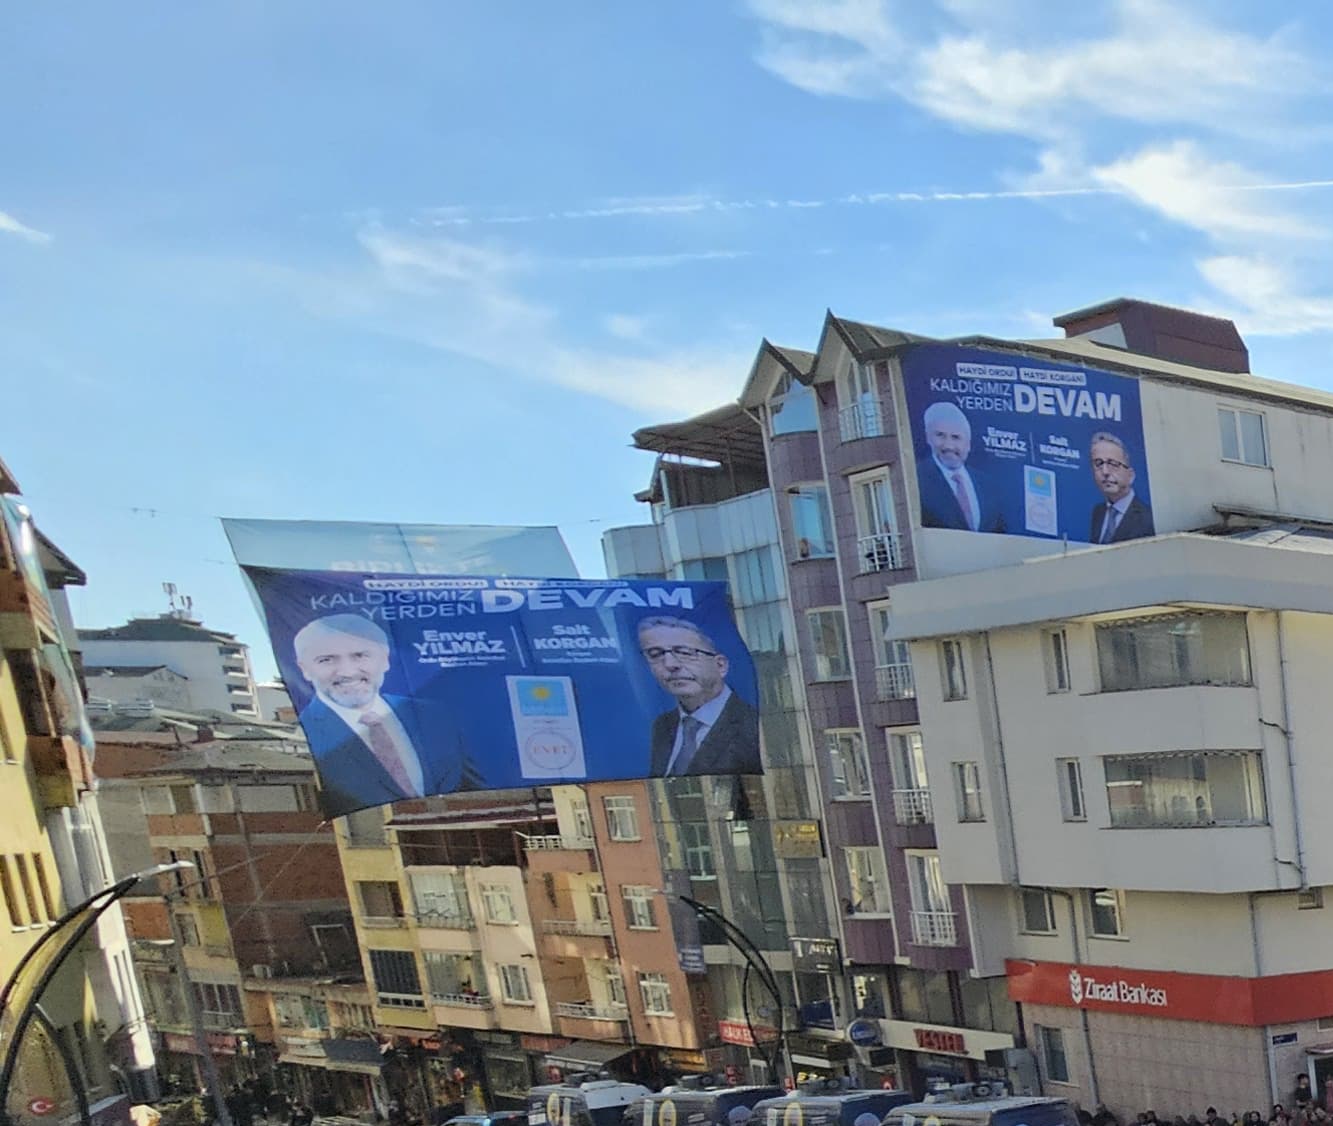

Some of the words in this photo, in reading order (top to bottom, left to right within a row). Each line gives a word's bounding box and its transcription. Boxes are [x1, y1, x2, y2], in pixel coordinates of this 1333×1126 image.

[956, 395, 1014, 412] YERDEN
[1014, 383, 1122, 422] DEVAM
[982, 436, 1028, 452] YILMAZ
[311, 588, 475, 610] KALDIĞIMIZ
[480, 586, 694, 613] DEVAM
[362, 602, 476, 621] YERDEN
[423, 629, 487, 642] Enver
[533, 636, 618, 650] KORGAN
[413, 640, 506, 656] YILMAZ
[1084, 977, 1120, 1003] Ziraat
[1120, 981, 1168, 1007] Bankası
